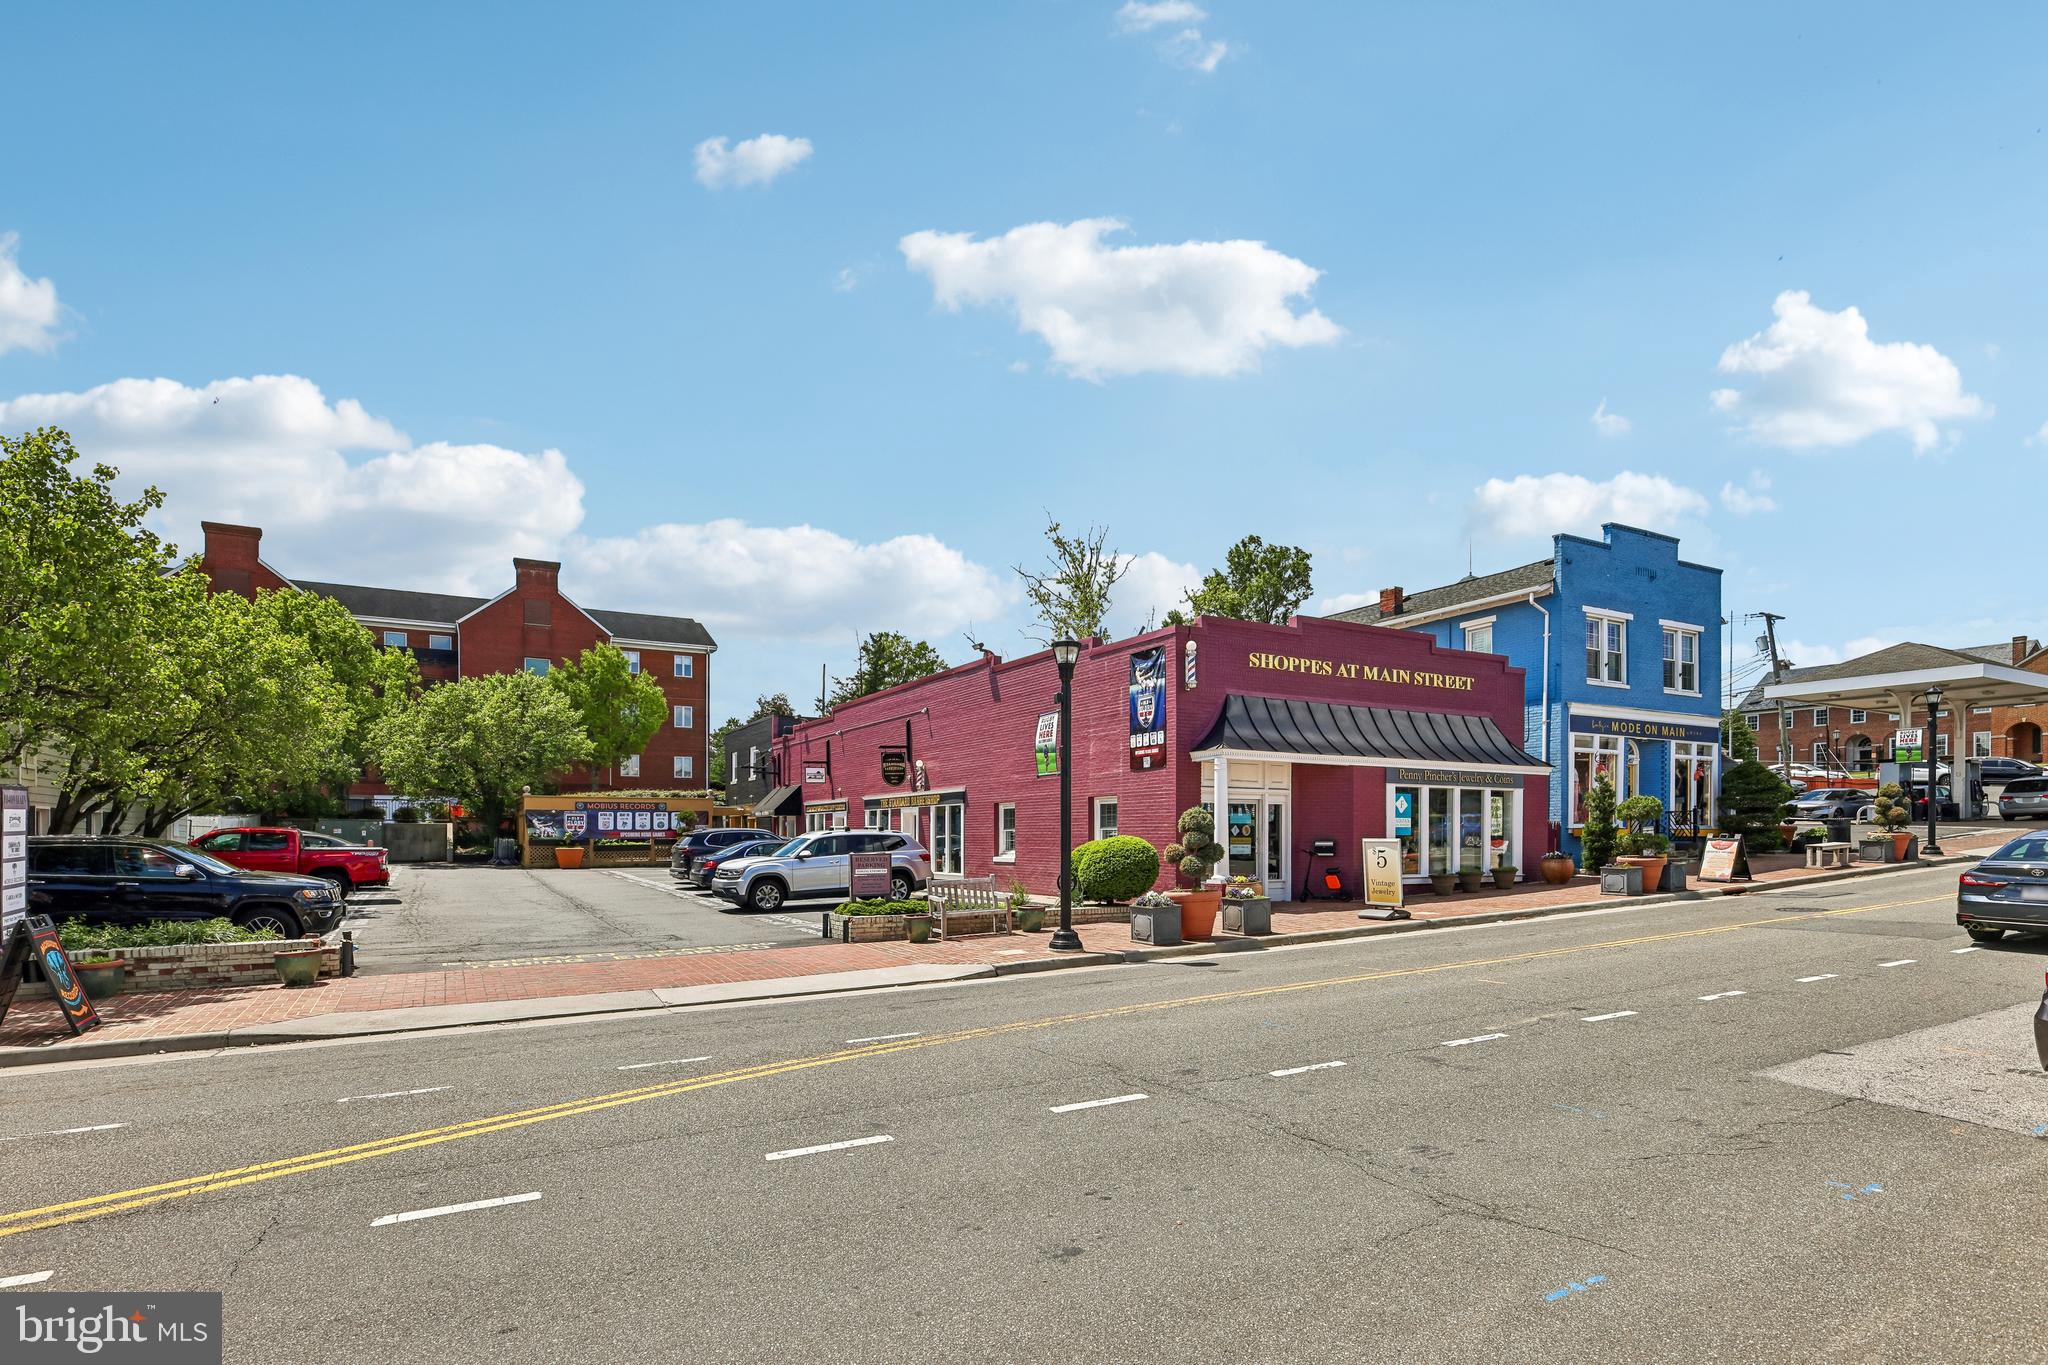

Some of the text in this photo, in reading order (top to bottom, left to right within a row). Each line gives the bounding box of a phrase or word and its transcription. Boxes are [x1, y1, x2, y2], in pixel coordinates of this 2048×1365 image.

[1249, 652, 1475, 691] SHOPPES AT MAIN STREET
[1040, 722, 1054, 730] LIVES
[1611, 721, 1641, 734] MODE
[1644, 724, 1658, 735] ON
[1661, 726, 1686, 737] MAIN
[1039, 730, 1054, 739] HERE
[1399, 769, 1514, 785] Penny Pincher's Jewelry & Coins
[880, 798, 889, 808] THE
[1371, 879, 1396, 888] Vintage
[1371, 888, 1396, 897] Jewelry
